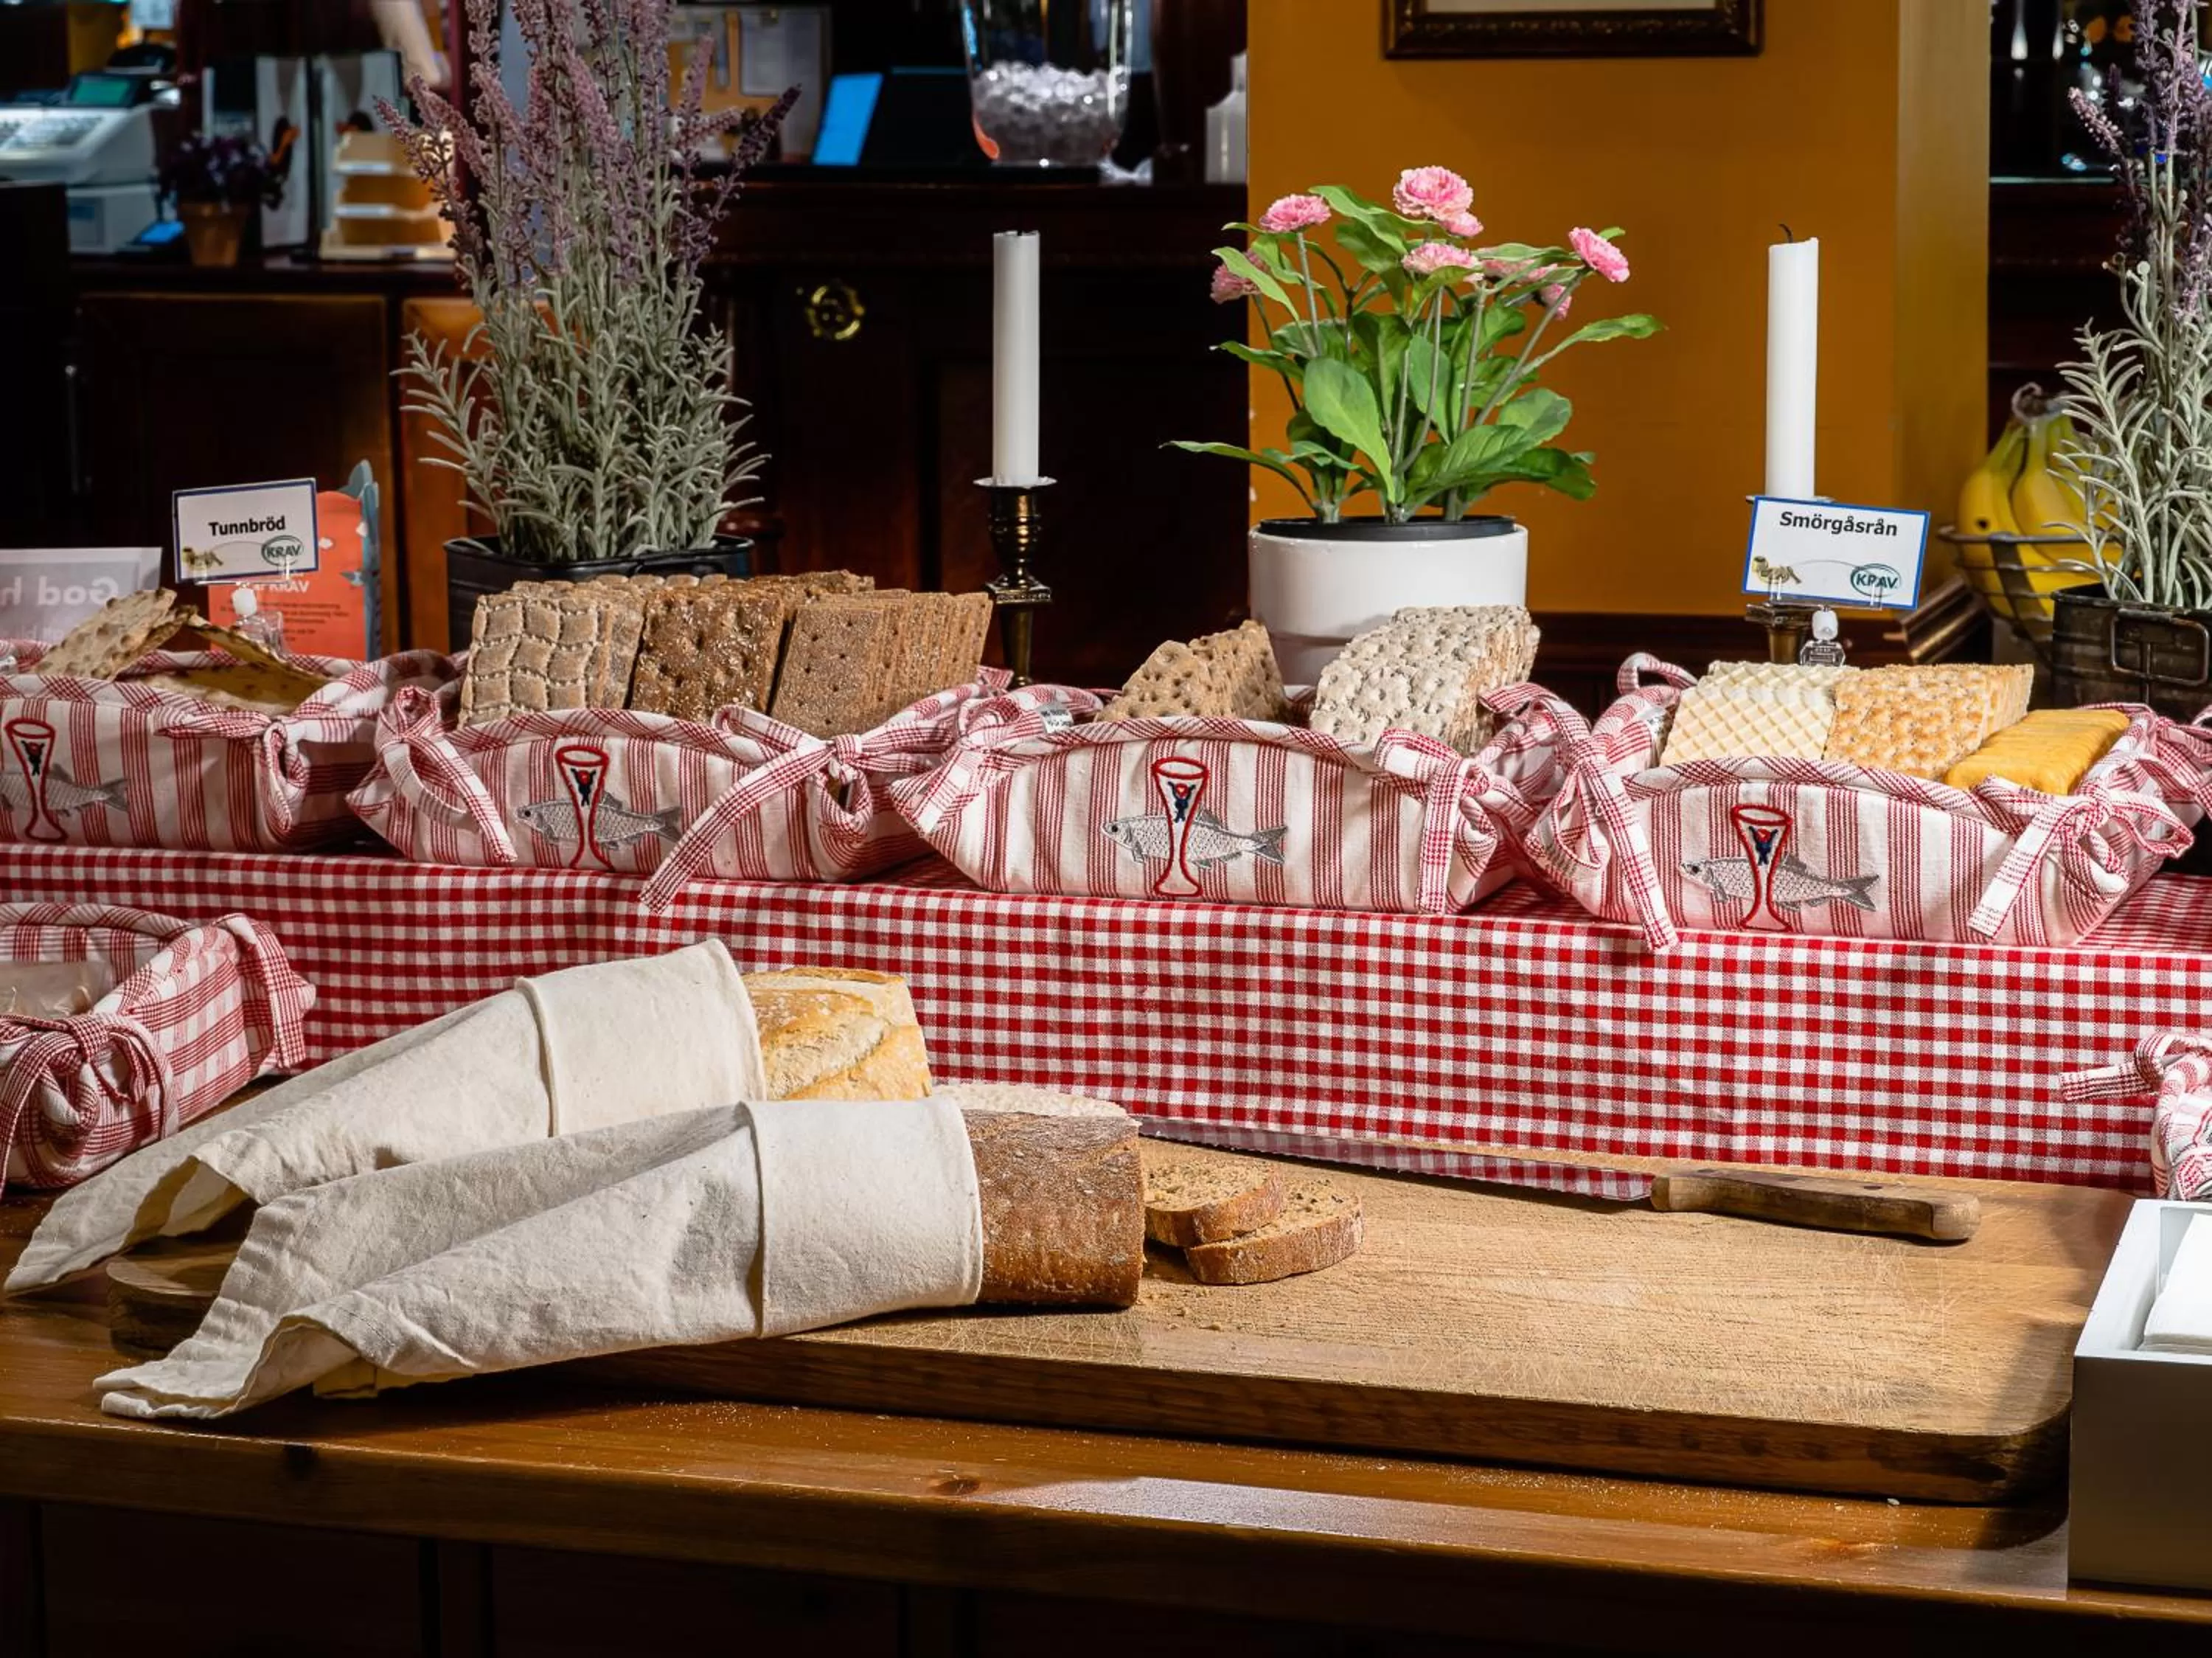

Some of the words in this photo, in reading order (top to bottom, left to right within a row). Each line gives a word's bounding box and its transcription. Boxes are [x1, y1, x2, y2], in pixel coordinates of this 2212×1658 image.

[208, 515, 286, 536] Tunnbröd
[1779, 511, 1898, 536] Smörgåsrån
[265, 545, 301, 558] KRAV
